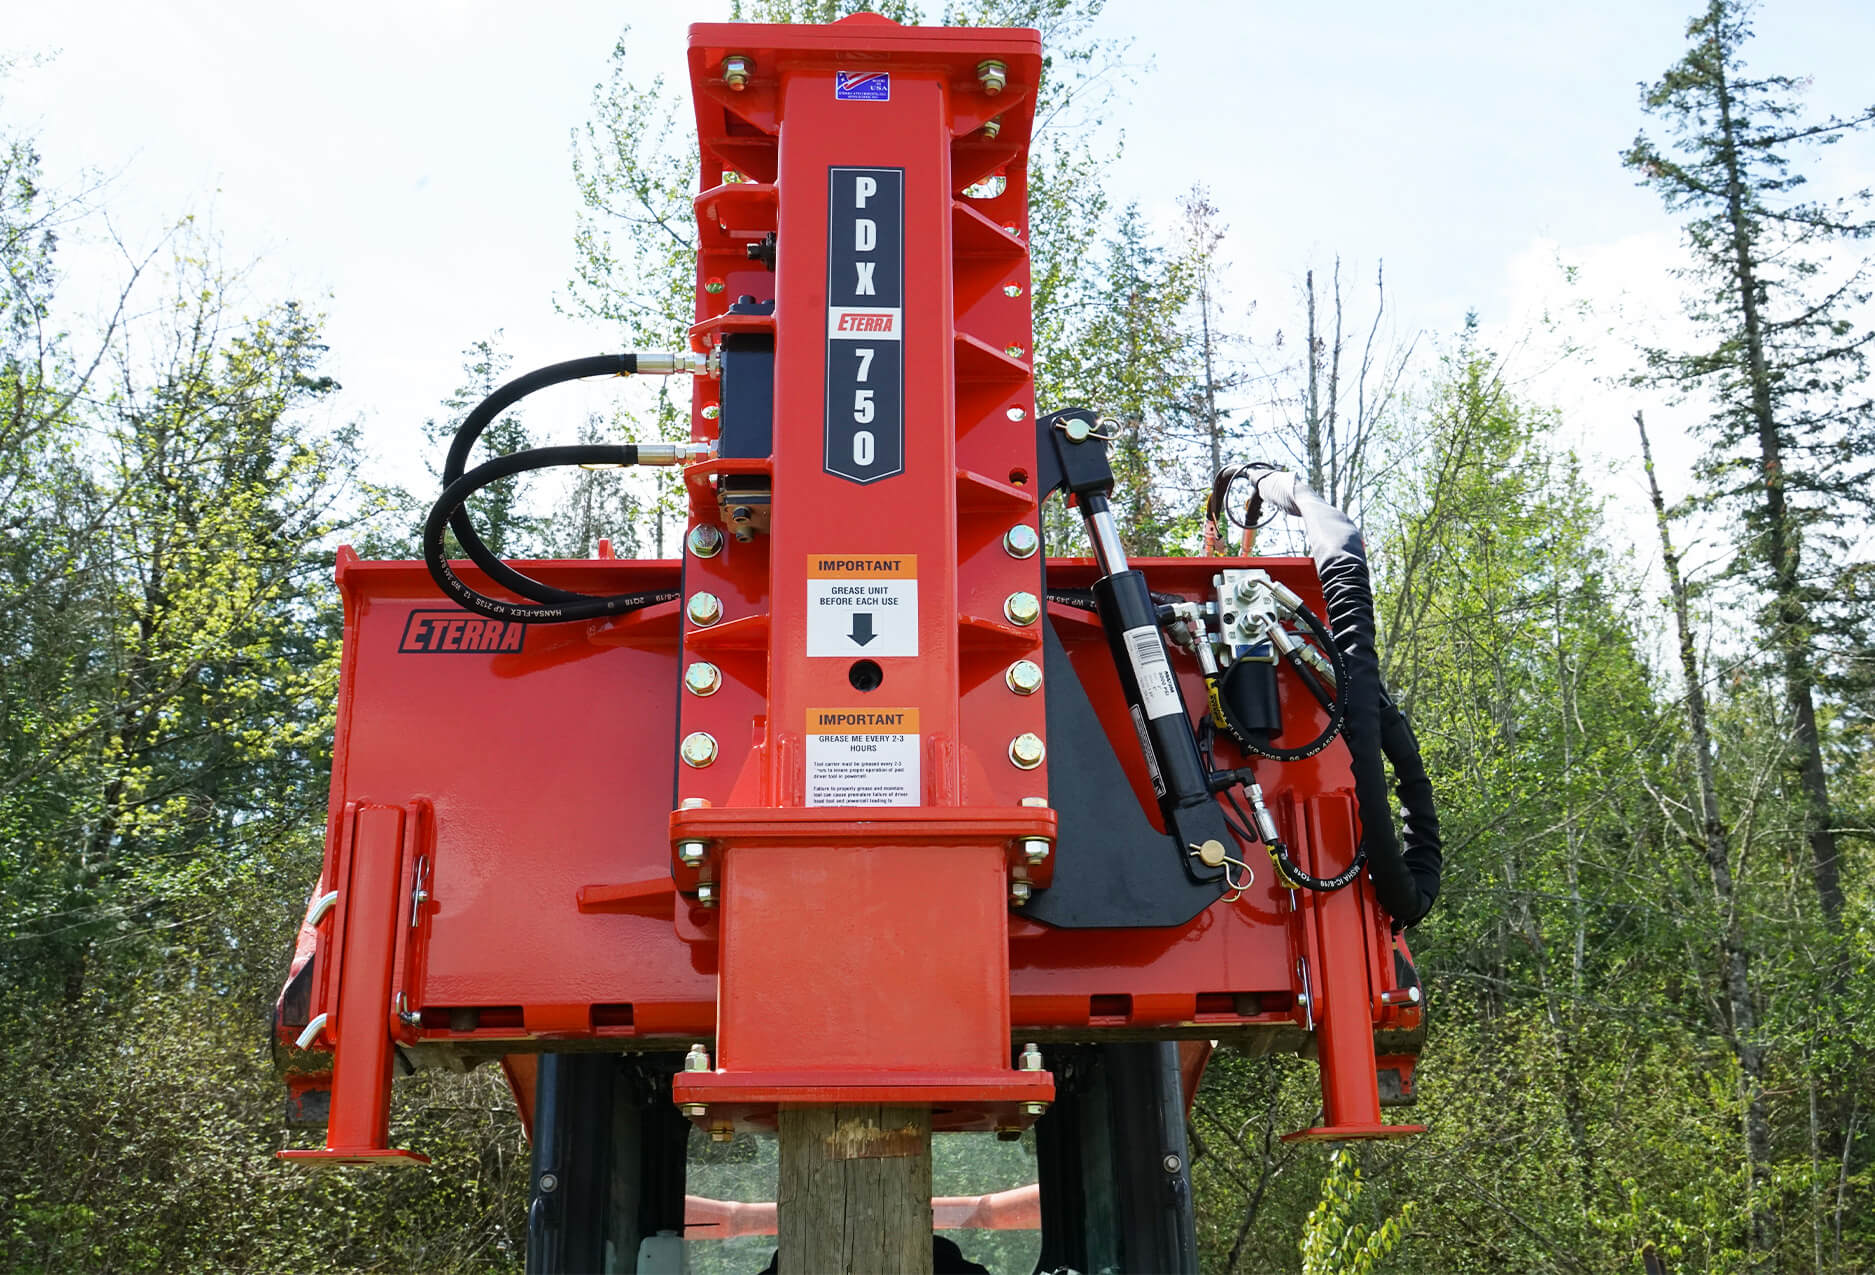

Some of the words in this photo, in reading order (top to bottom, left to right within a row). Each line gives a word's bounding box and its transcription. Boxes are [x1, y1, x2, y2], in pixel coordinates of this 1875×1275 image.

[855, 176, 877, 295] PDX
[853, 349, 875, 466] 750
[818, 560, 902, 571] IMPORTANT
[451, 580, 461, 591] WP
[831, 586, 865, 594] GREASE
[868, 586, 889, 594] UNIT
[463, 590, 471, 599] 12
[819, 597, 853, 605] BEFORE
[856, 597, 879, 605] EACH
[881, 597, 899, 605] USE
[510, 608, 562, 617] HANSA-FLEX
[819, 714, 904, 725] IMPORTANT
[1344, 865, 1361, 882] MSHA
